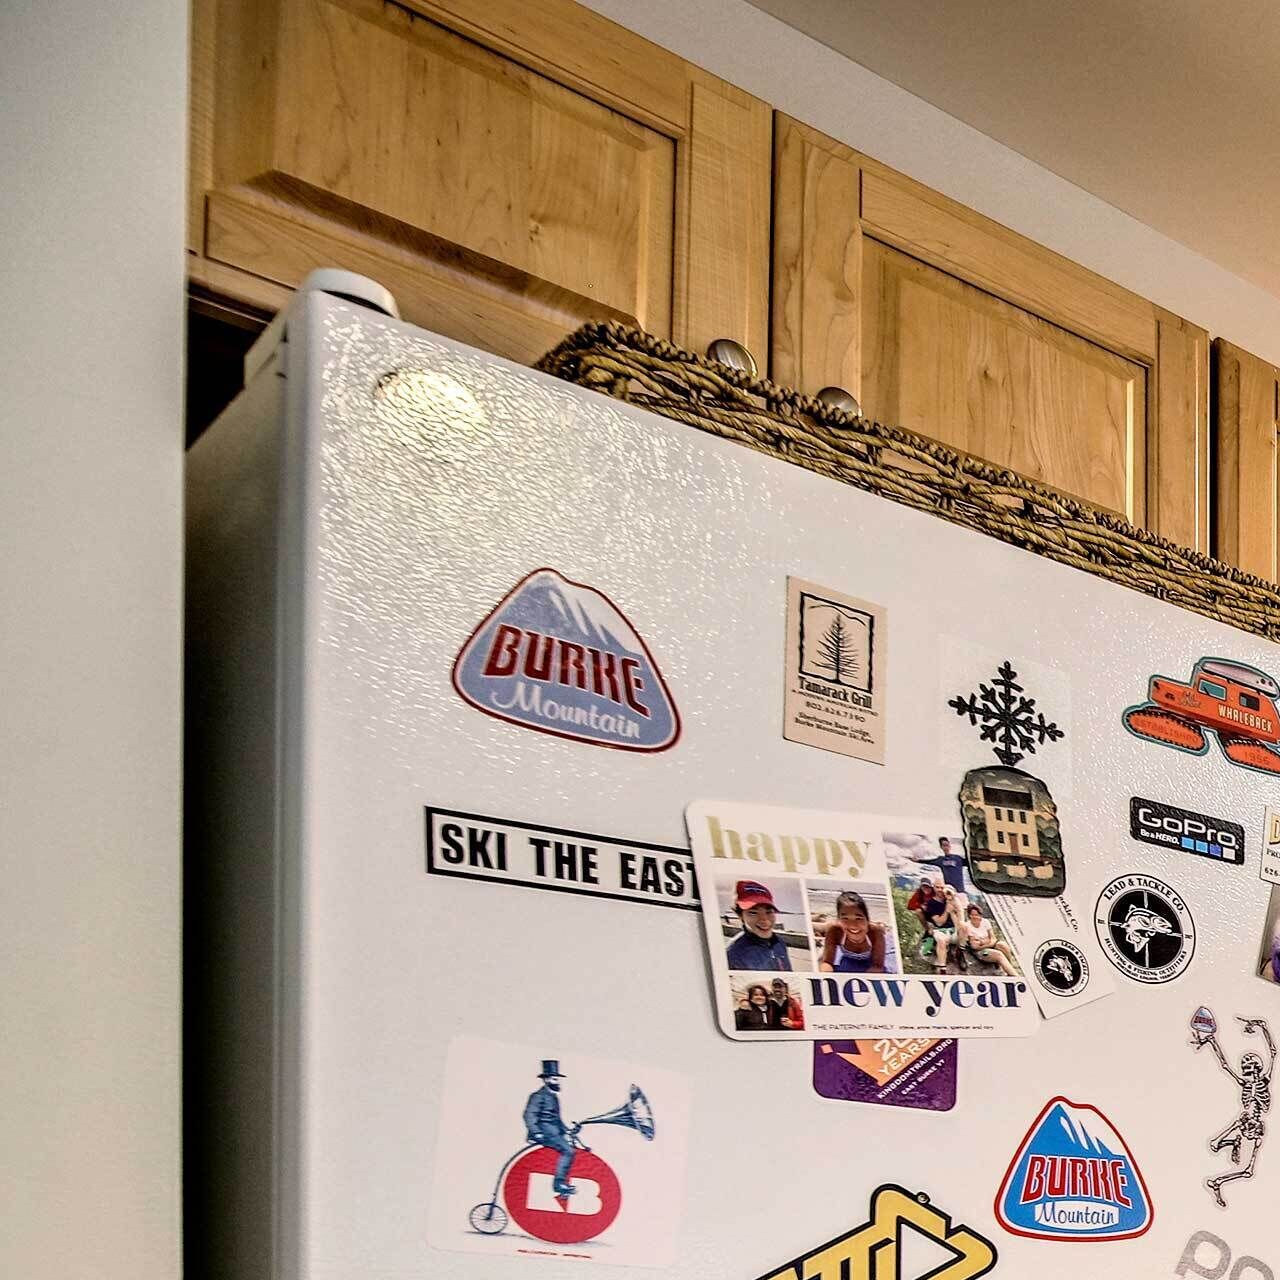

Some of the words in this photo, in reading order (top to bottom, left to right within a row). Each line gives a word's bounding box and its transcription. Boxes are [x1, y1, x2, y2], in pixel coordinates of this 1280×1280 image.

[481, 624, 652, 719] BURKE
[491, 682, 641, 738] Mountain
[798, 675, 850, 702] Tamarack
[851, 691, 873, 709] Grill
[1218, 703, 1273, 733] WHALEBACK
[441, 823, 508, 872] SKI
[529, 837, 600, 885] THE
[618, 851, 700, 900] EAST
[704, 815, 872, 879] happy
[1058, 895, 1073, 918] ackle
[1104, 880, 1126, 901] LEAD
[1128, 878, 1135, 887] &
[1136, 878, 1173, 899] TACKLE
[1172, 897, 1185, 915] CO.
[1104, 937, 1127, 966] HUNTING
[807, 977, 909, 1007] new
[920, 979, 1027, 1017] year
[877, 1038, 953, 1100] KINGDOMTRAILS.ORG
[879, 1038, 934, 1076] YEARS
[1019, 1154, 1133, 1209] BURKE
[1036, 1202, 1115, 1225] Mountain
